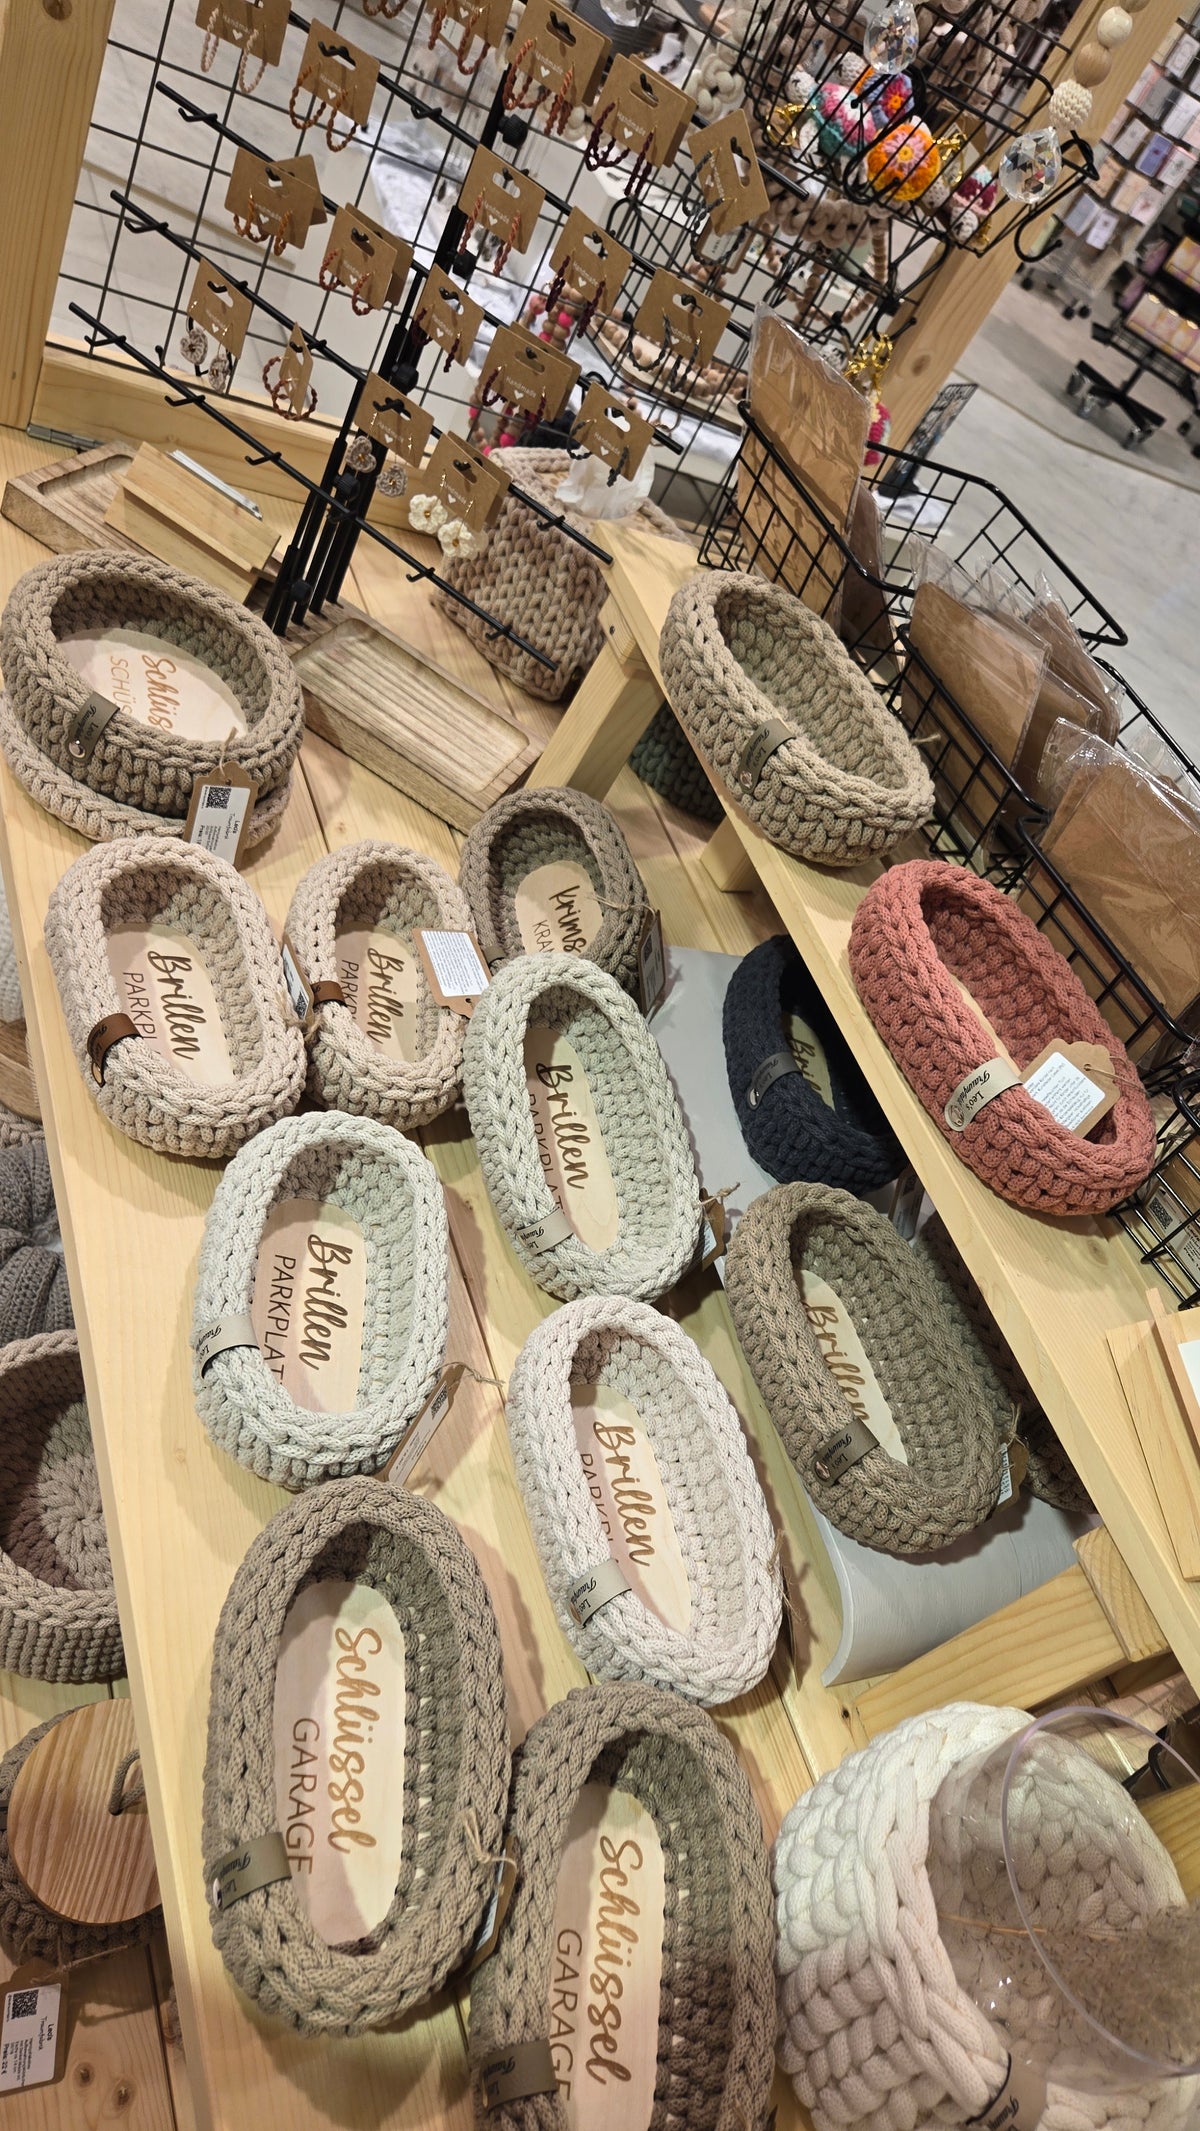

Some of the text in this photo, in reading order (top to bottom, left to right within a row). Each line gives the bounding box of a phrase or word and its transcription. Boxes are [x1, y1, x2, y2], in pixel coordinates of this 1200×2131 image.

[147, 949, 207, 1062] Brillen
[366, 946, 405, 1046] Brillen
[535, 1062, 591, 1191] Brillen
[966, 1088, 986, 1115] Leo's
[262, 1253, 298, 1385] PARKPLAT
[300, 1233, 353, 1372] Brillen
[592, 1419, 658, 1568] Brillen
[326, 1626, 384, 1856] Schlüssel
[585, 1834, 644, 2086] Schlüssel
